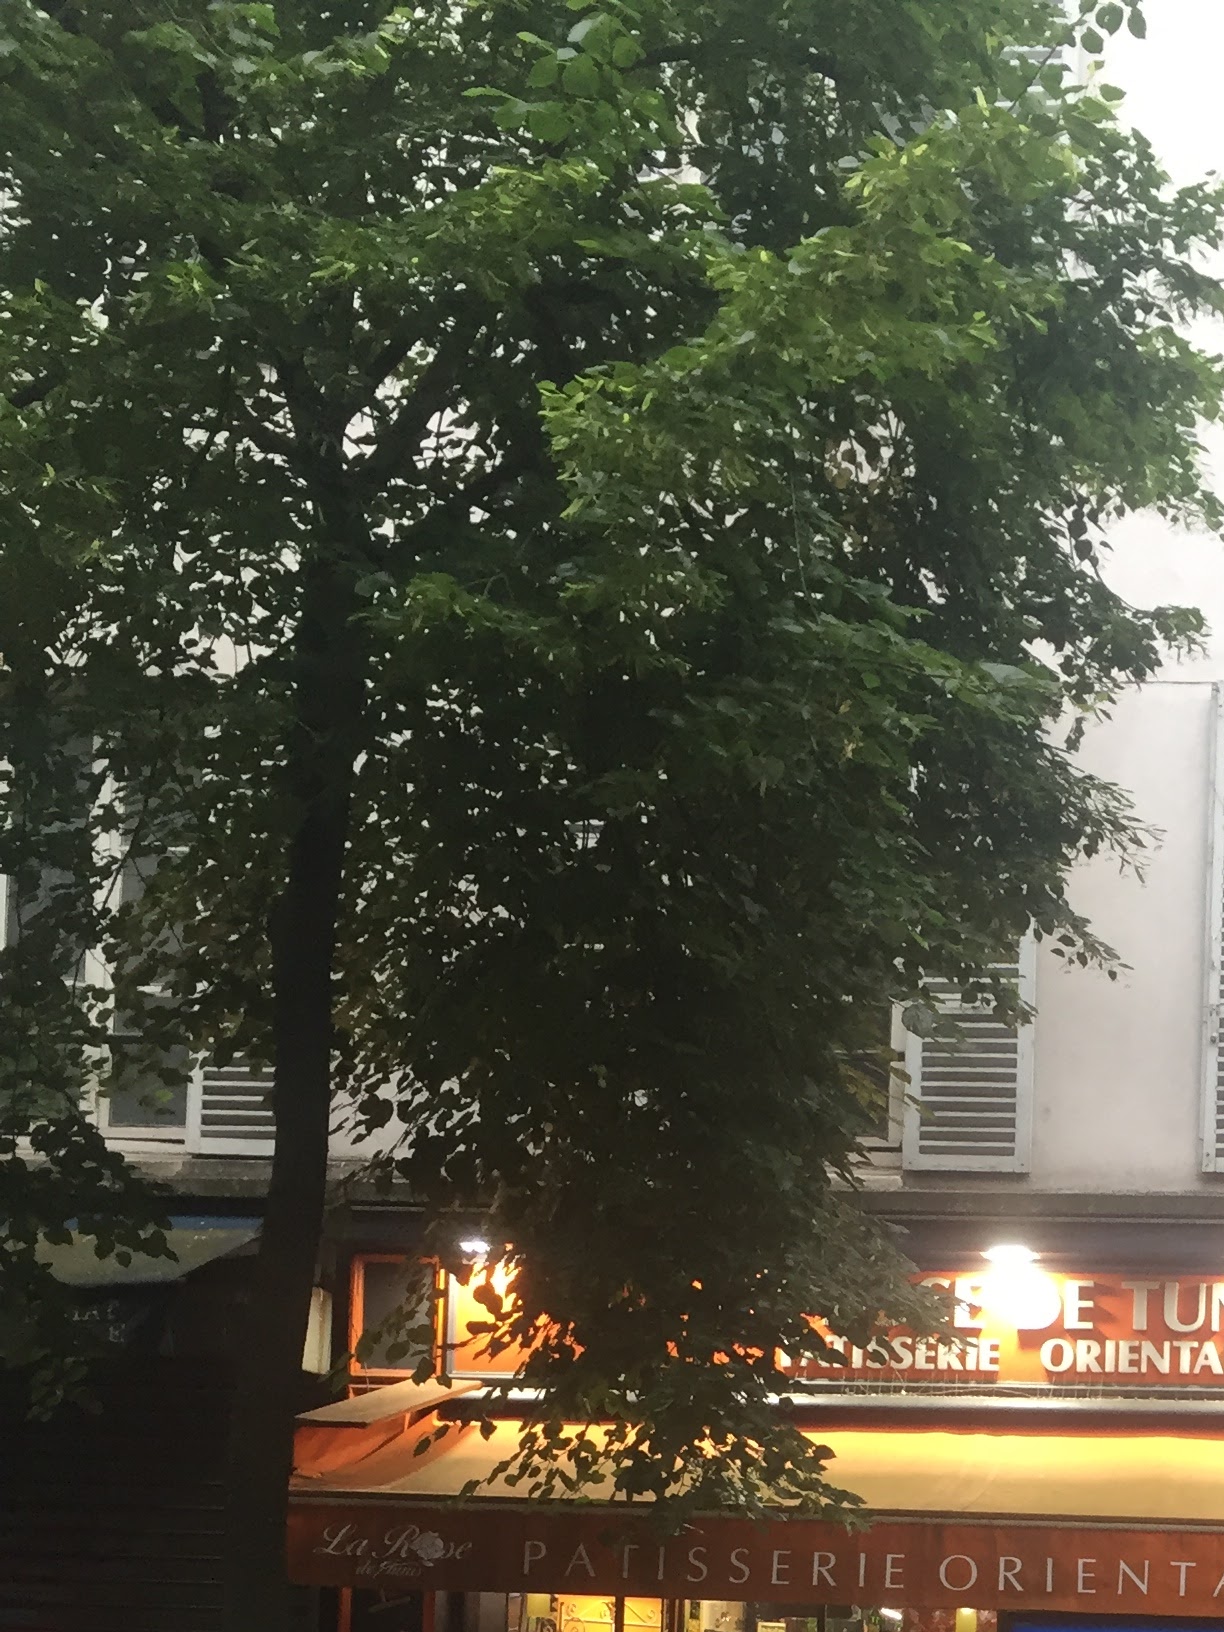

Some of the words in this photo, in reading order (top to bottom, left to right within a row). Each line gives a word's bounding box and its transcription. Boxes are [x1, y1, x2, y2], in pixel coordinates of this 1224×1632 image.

[312, 1523, 369, 1556] La
[371, 1524, 473, 1564] Rose
[522, 1540, 906, 1589] PATISSERIE
